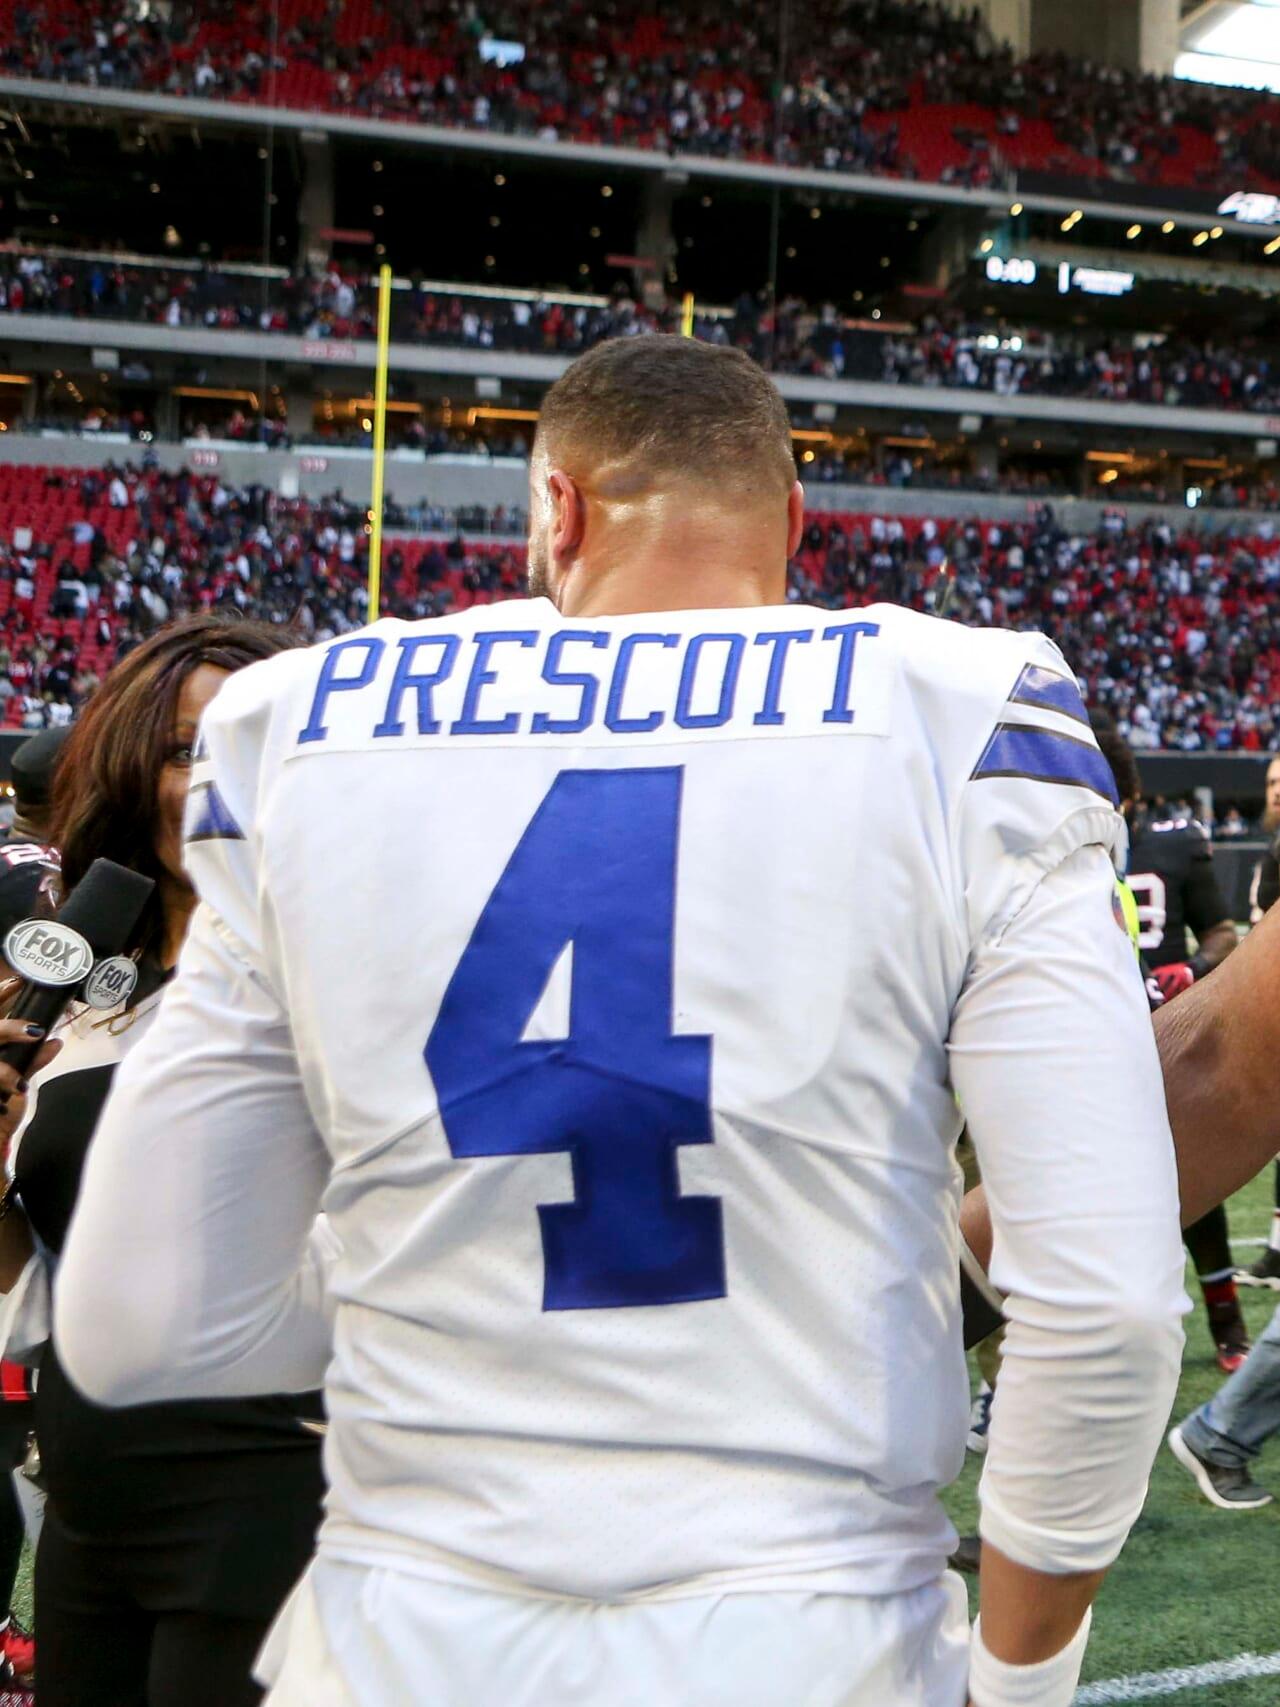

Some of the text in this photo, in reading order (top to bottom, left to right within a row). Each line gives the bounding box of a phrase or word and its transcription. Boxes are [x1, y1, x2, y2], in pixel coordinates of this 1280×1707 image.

[298, 622, 880, 744] PRESCOTT
[18, 949, 67, 977] SPORTS
[24, 928, 79, 968] FOX
[98, 964, 132, 993] FOX
[424, 765, 728, 1312] 4
